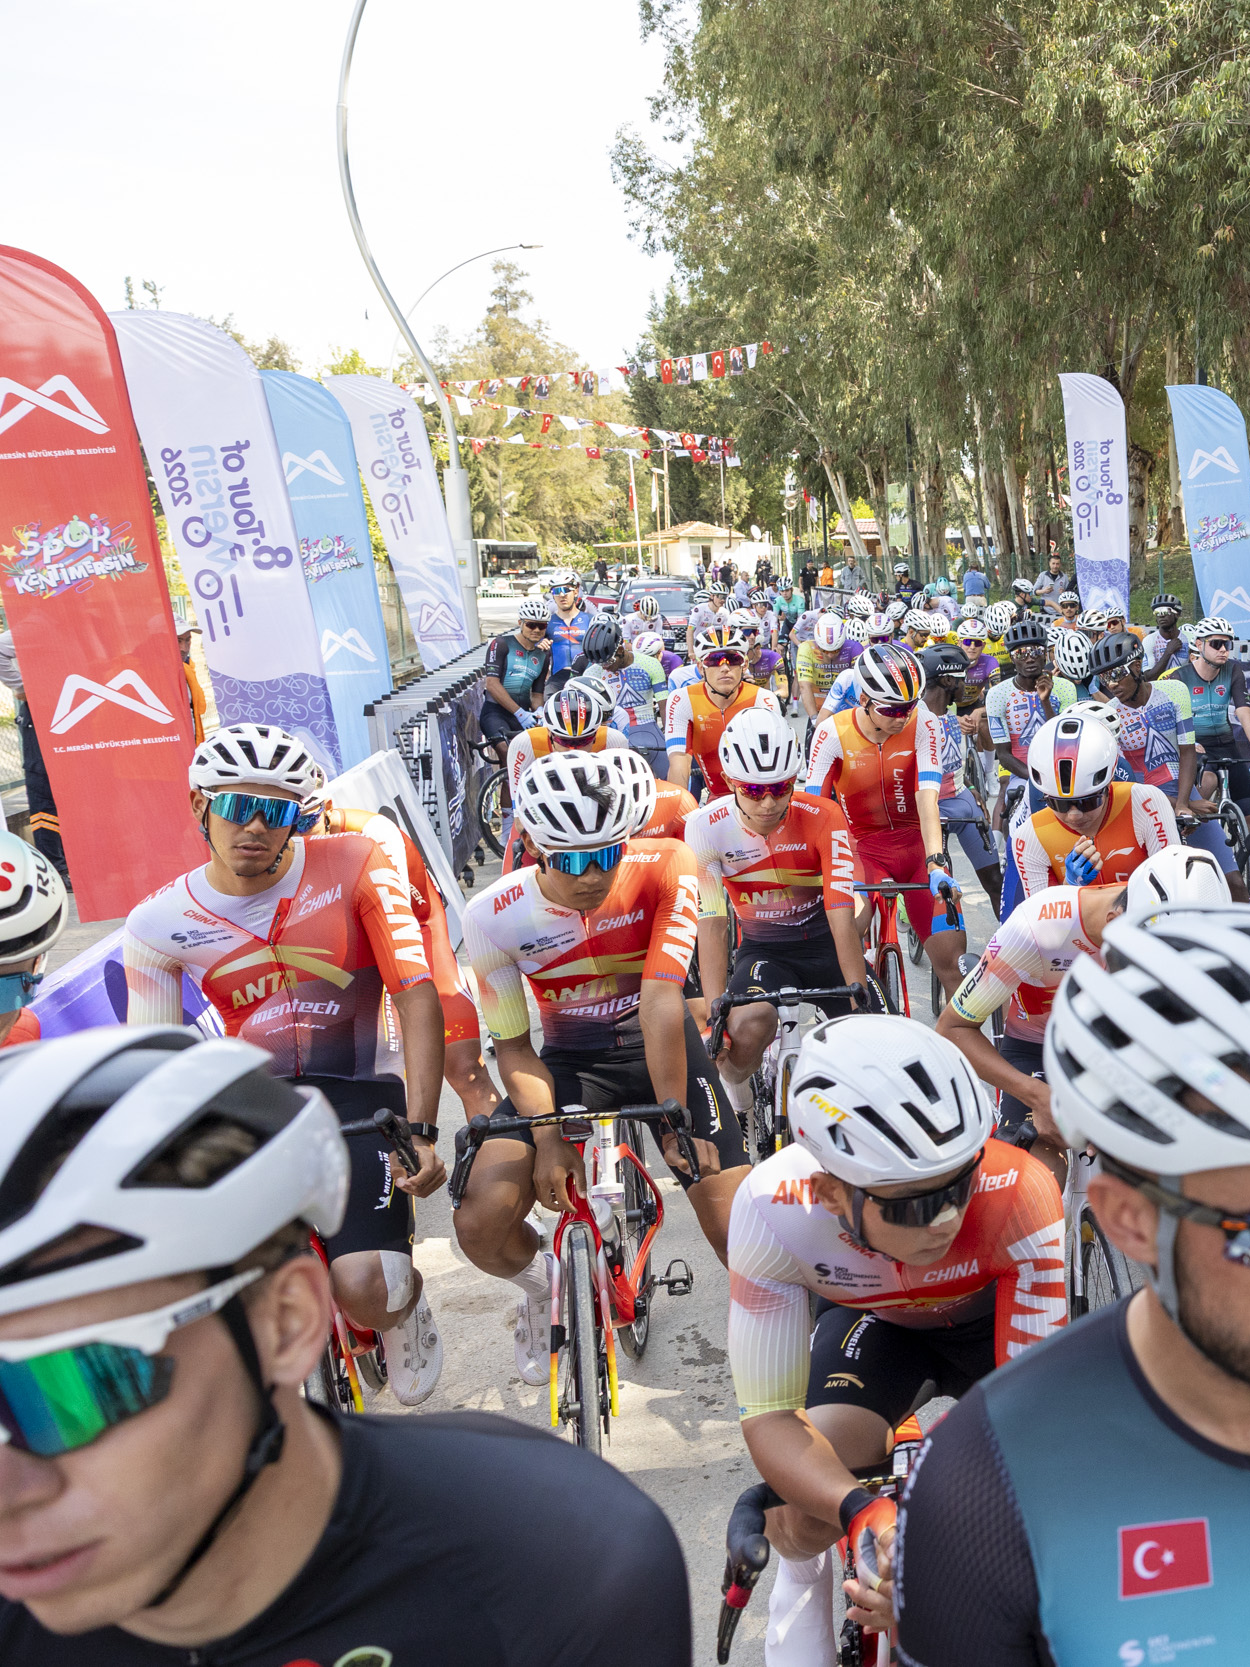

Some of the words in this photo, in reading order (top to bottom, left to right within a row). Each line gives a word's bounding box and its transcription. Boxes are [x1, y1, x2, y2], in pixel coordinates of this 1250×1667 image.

[27, 447, 76, 459] BÜYÜKŞEHİR
[76, 445, 117, 456] BELEDİYESİ
[667, 694, 681, 734] LI-NING
[66, 742, 94, 752] MERSİN
[95, 738, 142, 749] BÜYÜKŞEHİR
[142, 733, 181, 744] BELEDİYESİ
[925, 720, 939, 767] LI-NING
[1148, 752, 1179, 771] AMANI
[894, 768, 907, 813] LI-NING
[708, 806, 730, 826] ANTA
[791, 800, 820, 815] mentech
[774, 843, 807, 852] CHINA
[830, 829, 855, 899] ANTA
[299, 883, 343, 917] CHINA
[493, 883, 525, 915] ANTA
[739, 887, 794, 906] ANTA
[183, 909, 219, 927] CHINA
[545, 906, 573, 919] CHINA
[596, 909, 645, 932] CHINA
[1038, 901, 1072, 921] ANTA
[661, 874, 699, 974] ANTA
[231, 969, 299, 1010] ANTA
[542, 975, 618, 1003] ANTA
[251, 998, 341, 1027] mentech
[703, 1077, 717, 1118] MICHELIN
[809, 1093, 853, 1122] PMT
[384, 1151, 393, 1194] MICHELIN
[834, 1266, 849, 1274] UCI
[834, 1272, 882, 1281] CONTINENTAL
[923, 1258, 979, 1283] CHINA
[844, 1319, 872, 1359] MICHELIN
[824, 1379, 850, 1390] ANTA
